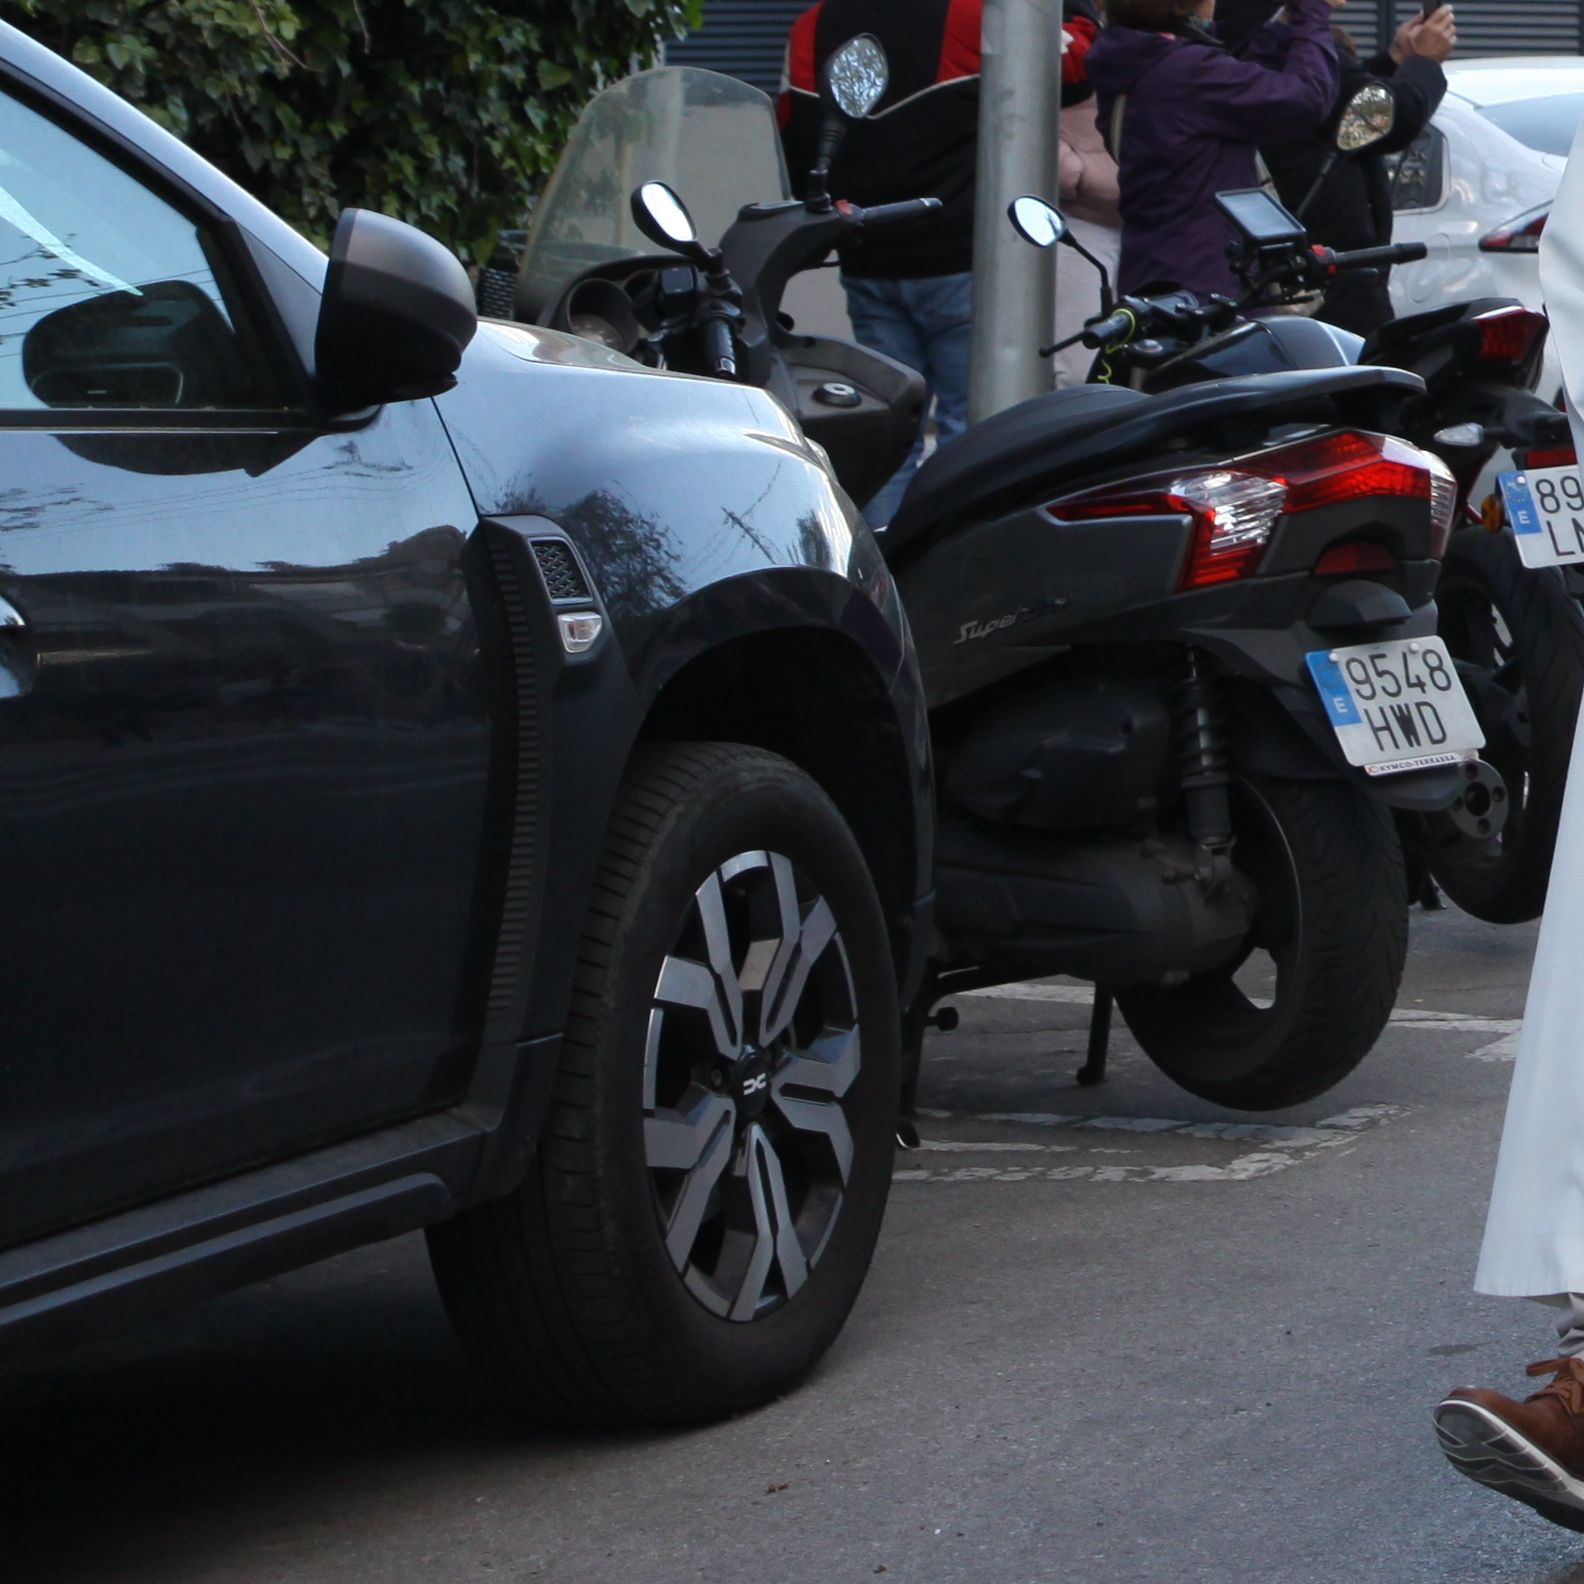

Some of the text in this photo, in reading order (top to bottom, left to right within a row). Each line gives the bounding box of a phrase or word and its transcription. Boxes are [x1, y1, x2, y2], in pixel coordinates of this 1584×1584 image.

[1518, 510, 1530, 525] E
[1345, 648, 1452, 700] 9548
[1332, 697, 1447, 752] E HWD
